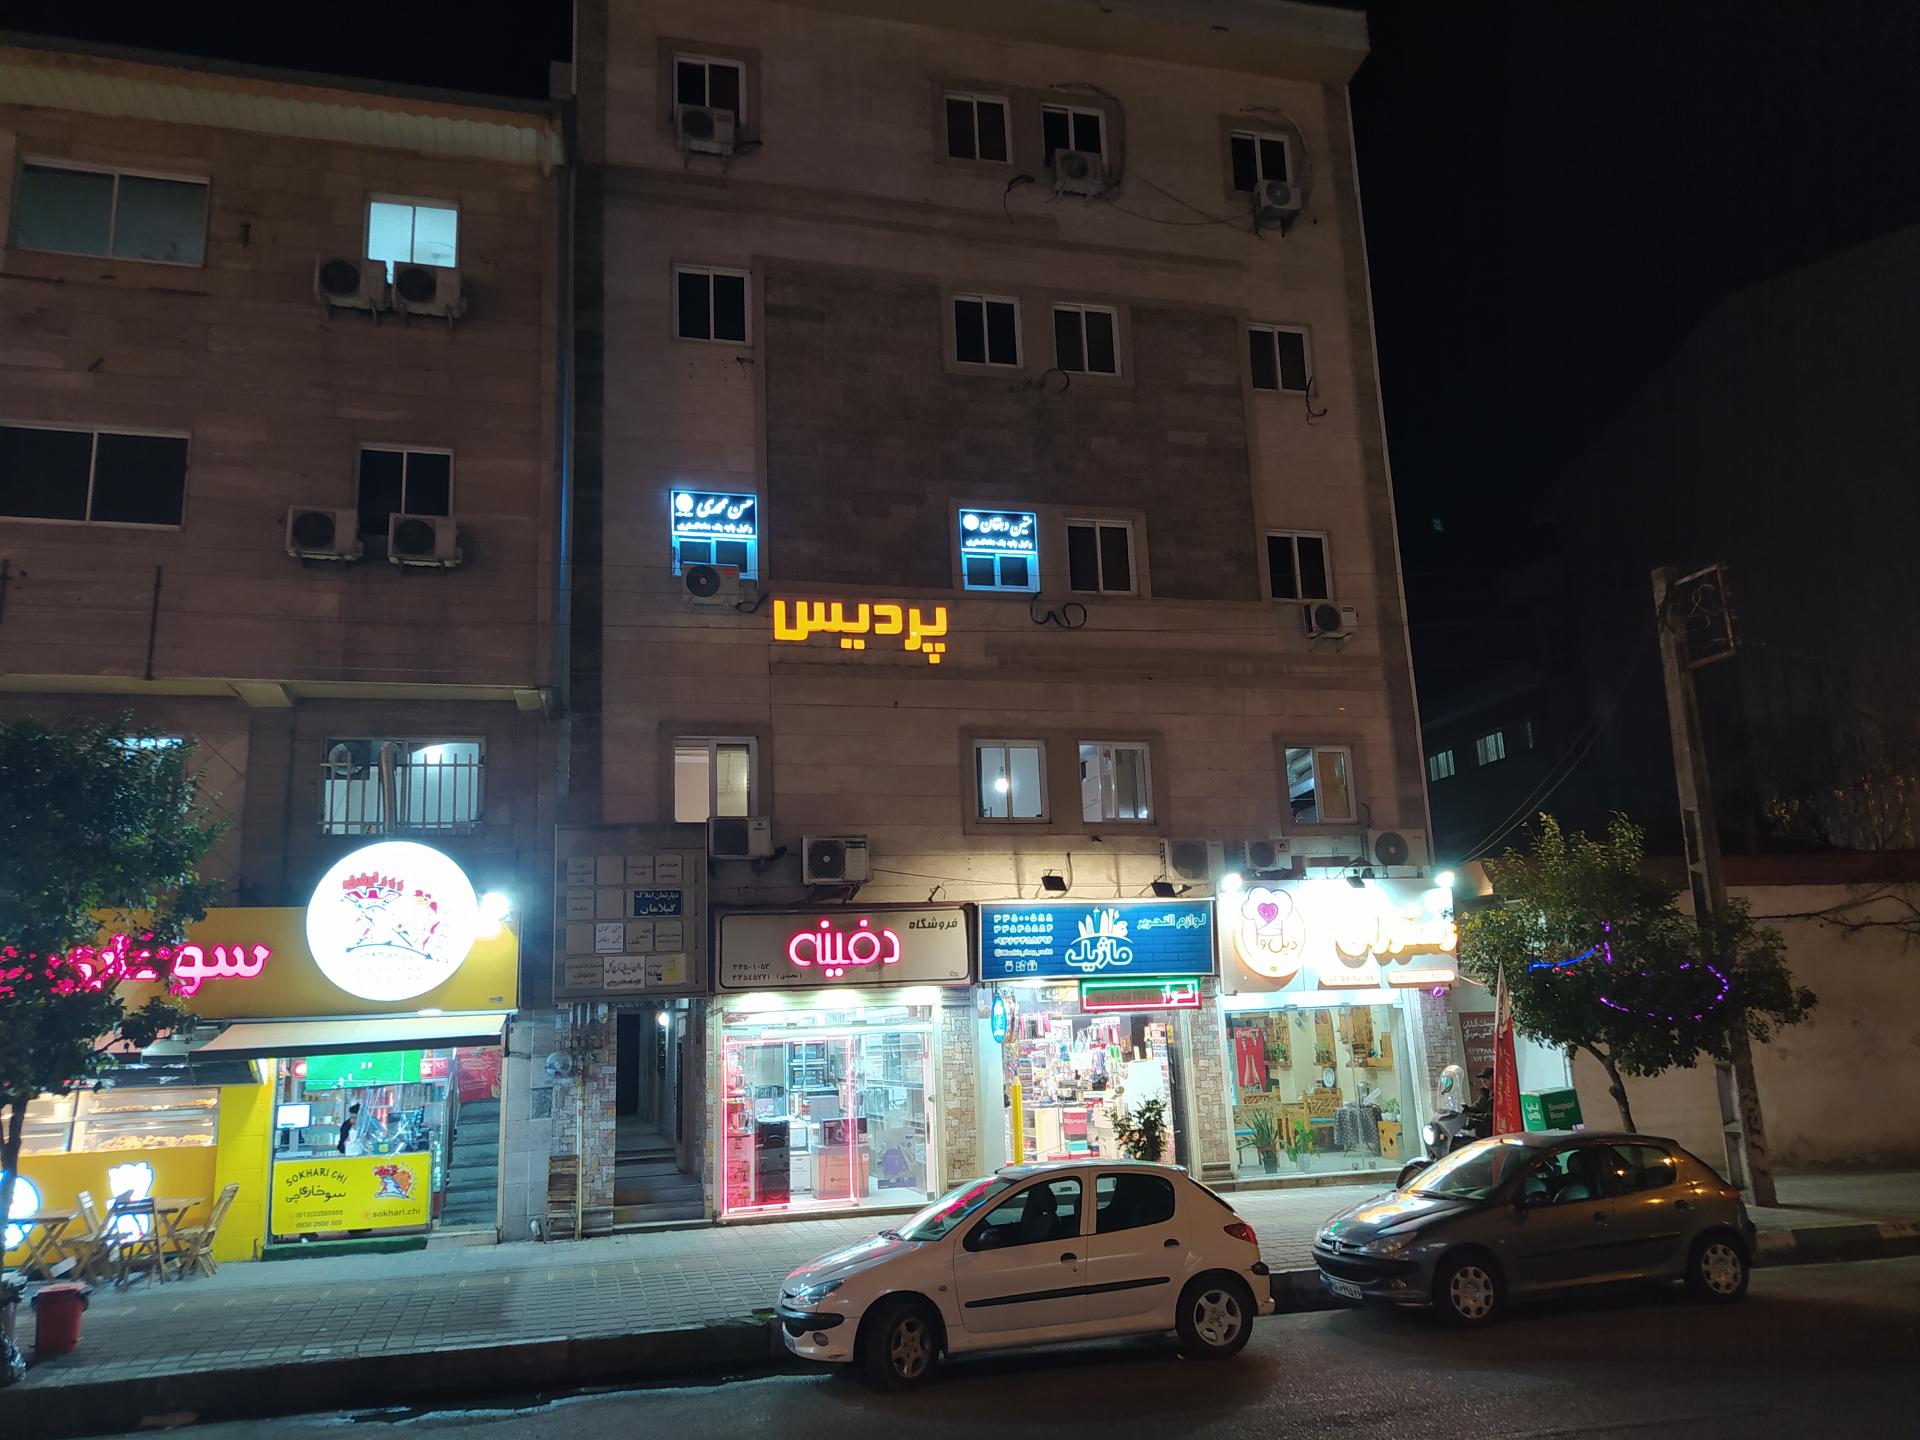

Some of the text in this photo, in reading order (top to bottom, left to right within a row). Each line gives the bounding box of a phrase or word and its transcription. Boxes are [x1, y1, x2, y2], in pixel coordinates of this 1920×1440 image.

[773, 599, 948, 664] پردیس
[908, 917, 958, 930] فروشگاه
[1137, 913, 1206, 929] لوازم التحریر
[788, 918, 901, 979] دفینه
[1064, 936, 1133, 972] ماژیک
[286, 1167, 348, 1187] SOKHARI CHI
[299, 1184, 347, 1203] سوخاری
[372, 1207, 421, 1218] sokhari.chi
